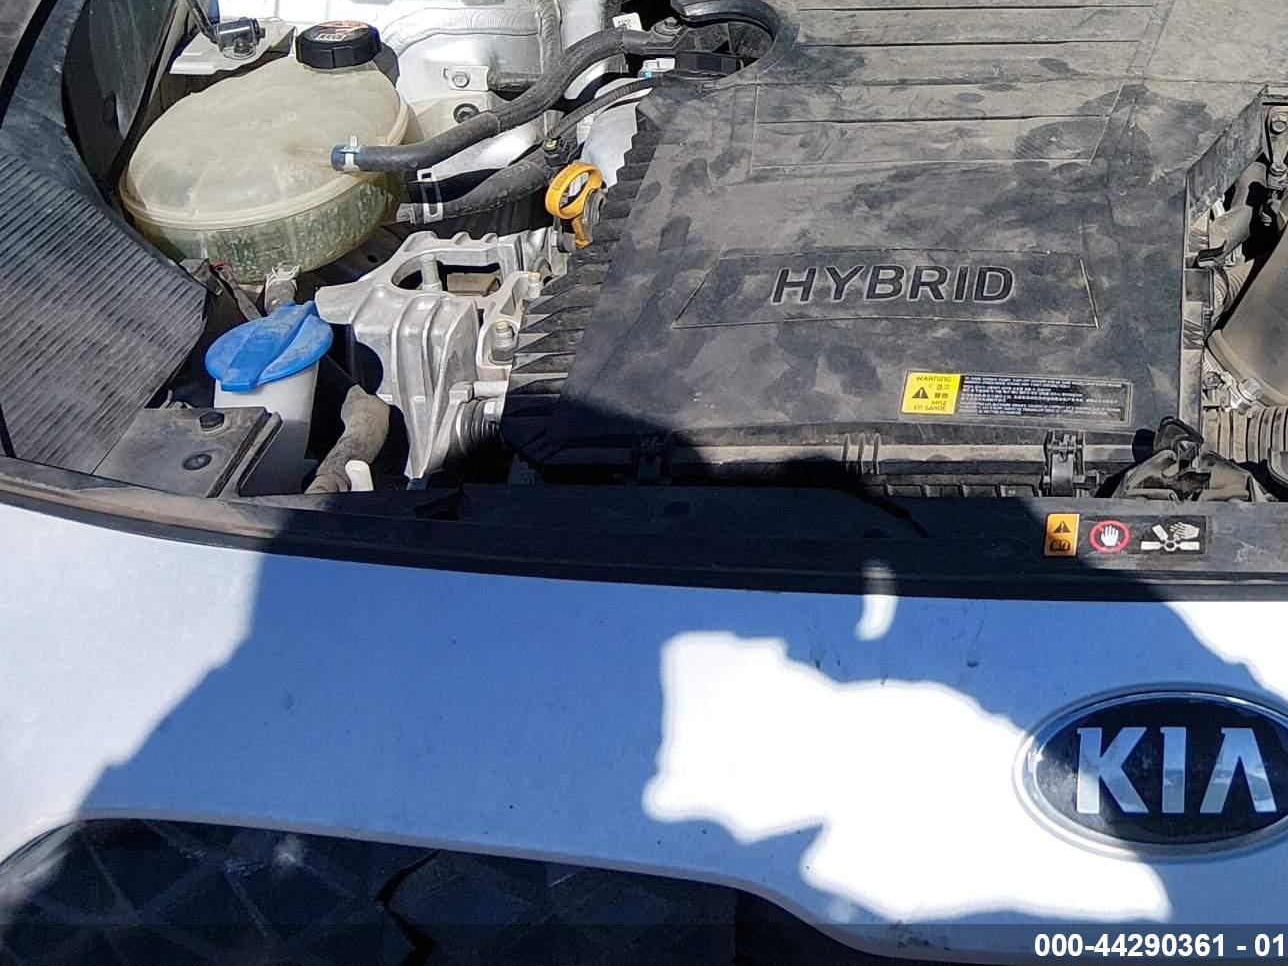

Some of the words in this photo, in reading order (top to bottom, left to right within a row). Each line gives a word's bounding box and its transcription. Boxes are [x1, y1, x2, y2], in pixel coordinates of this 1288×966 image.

[771, 264, 1014, 304] HYBRID
[915, 375, 952, 383] WARNING
[1076, 726, 1277, 814] KIA
